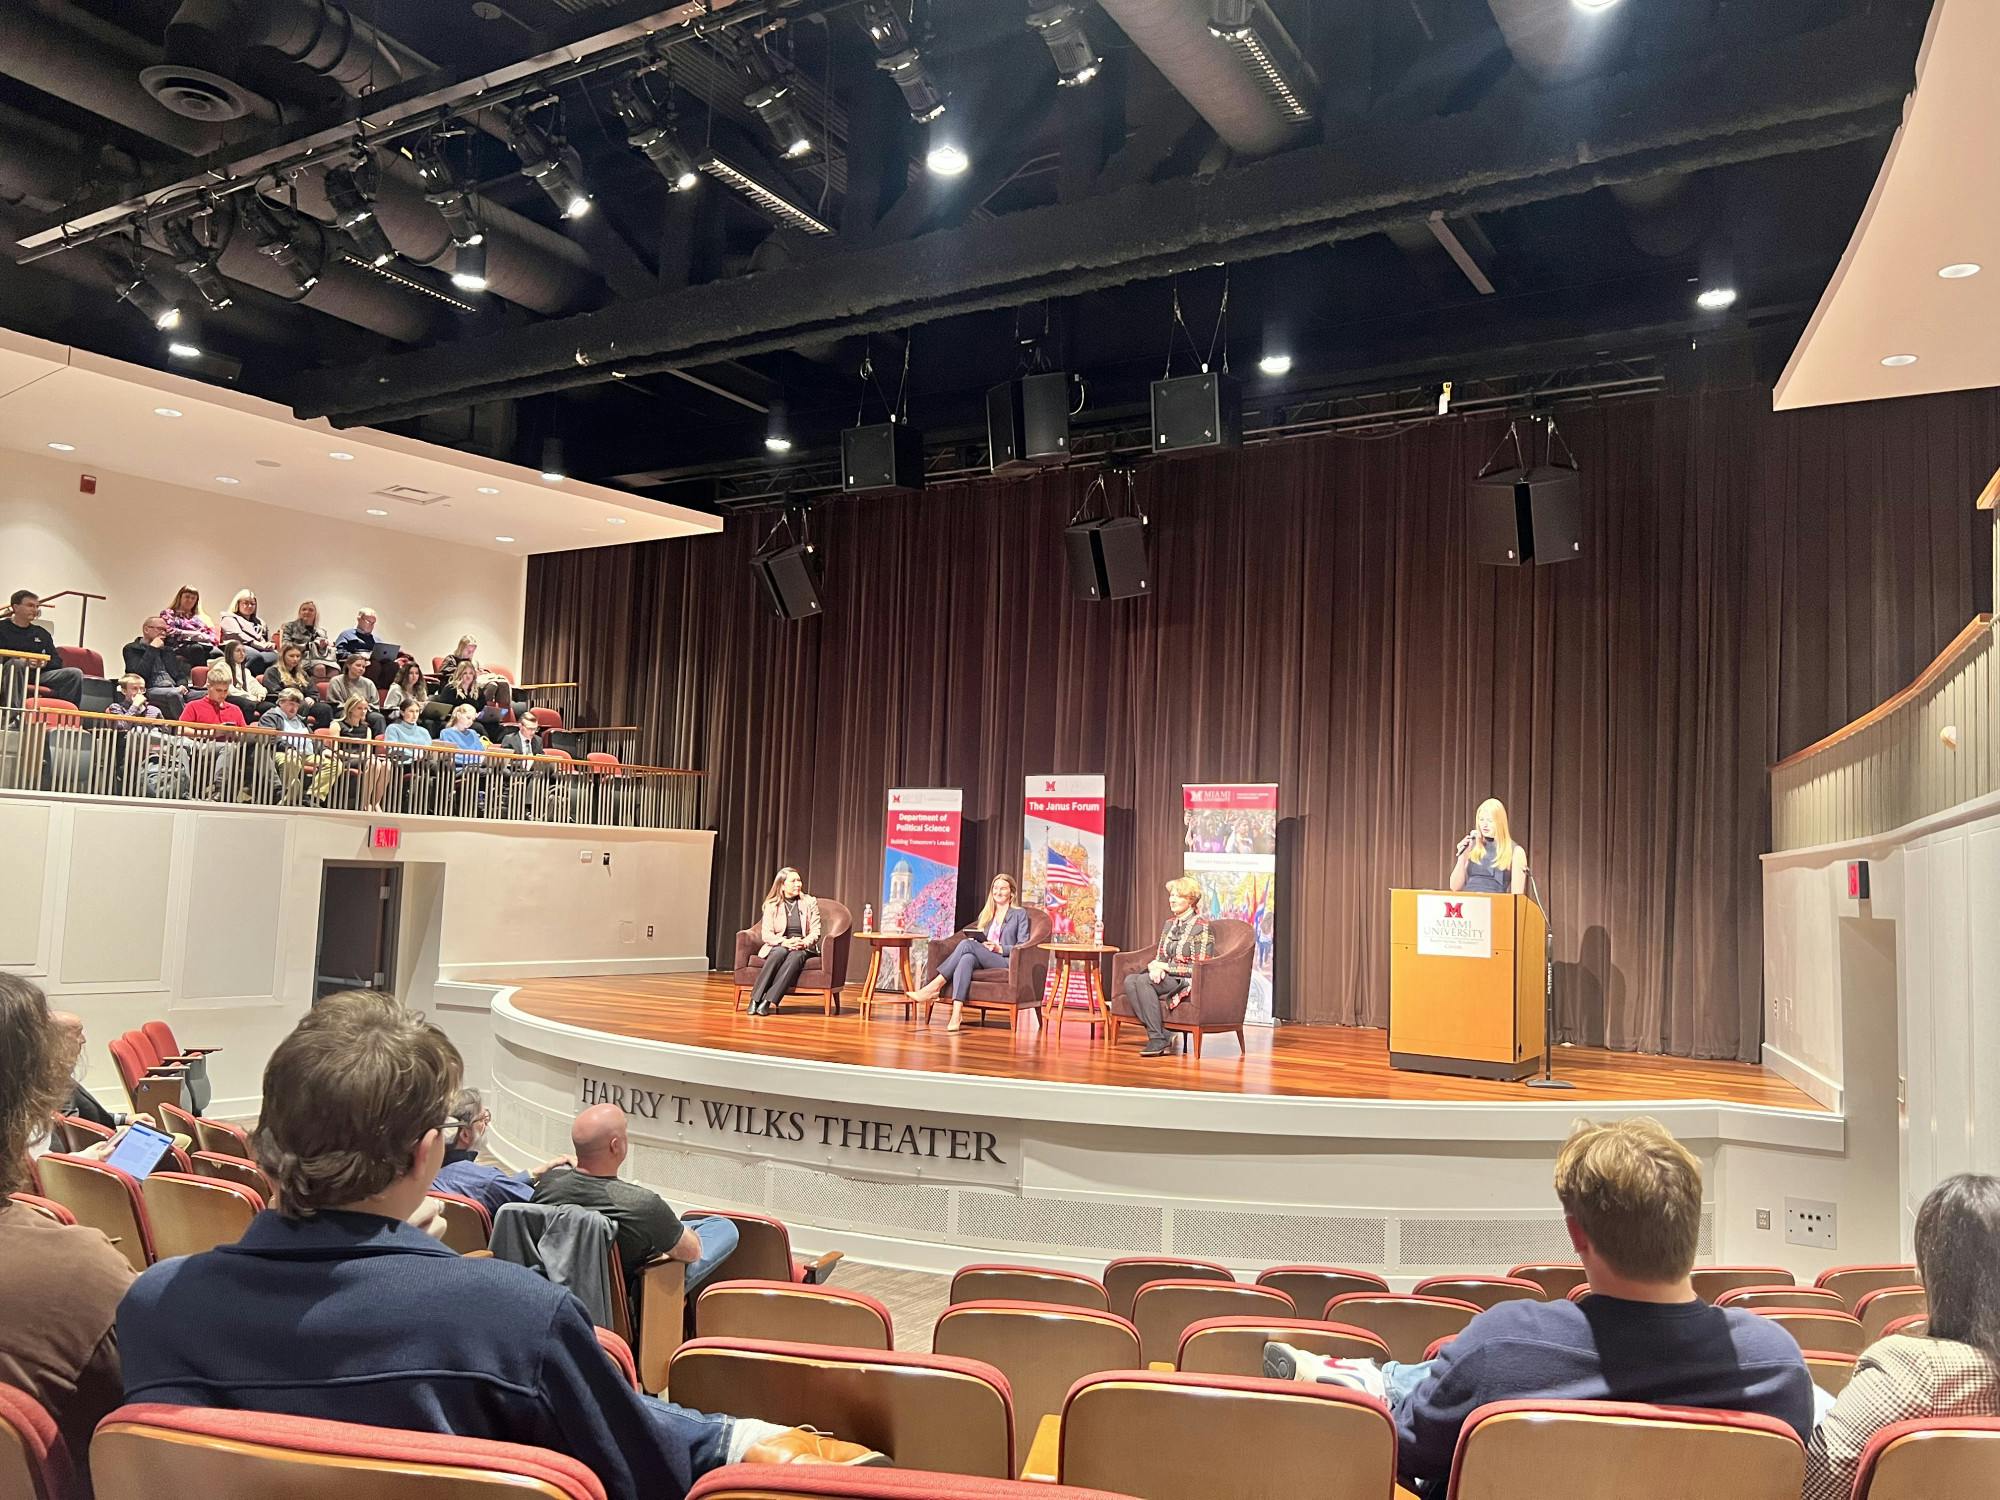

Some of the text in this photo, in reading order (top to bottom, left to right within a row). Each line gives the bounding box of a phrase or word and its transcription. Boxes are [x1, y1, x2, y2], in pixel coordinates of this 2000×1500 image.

[1029, 802, 1100, 811] The Janus Forum
[899, 813, 948, 822] Department of
[896, 824, 951, 833] Political Science
[376, 828, 398, 848] EXIT
[1444, 902, 1463, 918] M
[1436, 920, 1471, 928] MIAMI
[1423, 927, 1484, 937] UNIVERSITY
[582, 1077, 1007, 1164] HARRY T. WILKS THEATER
